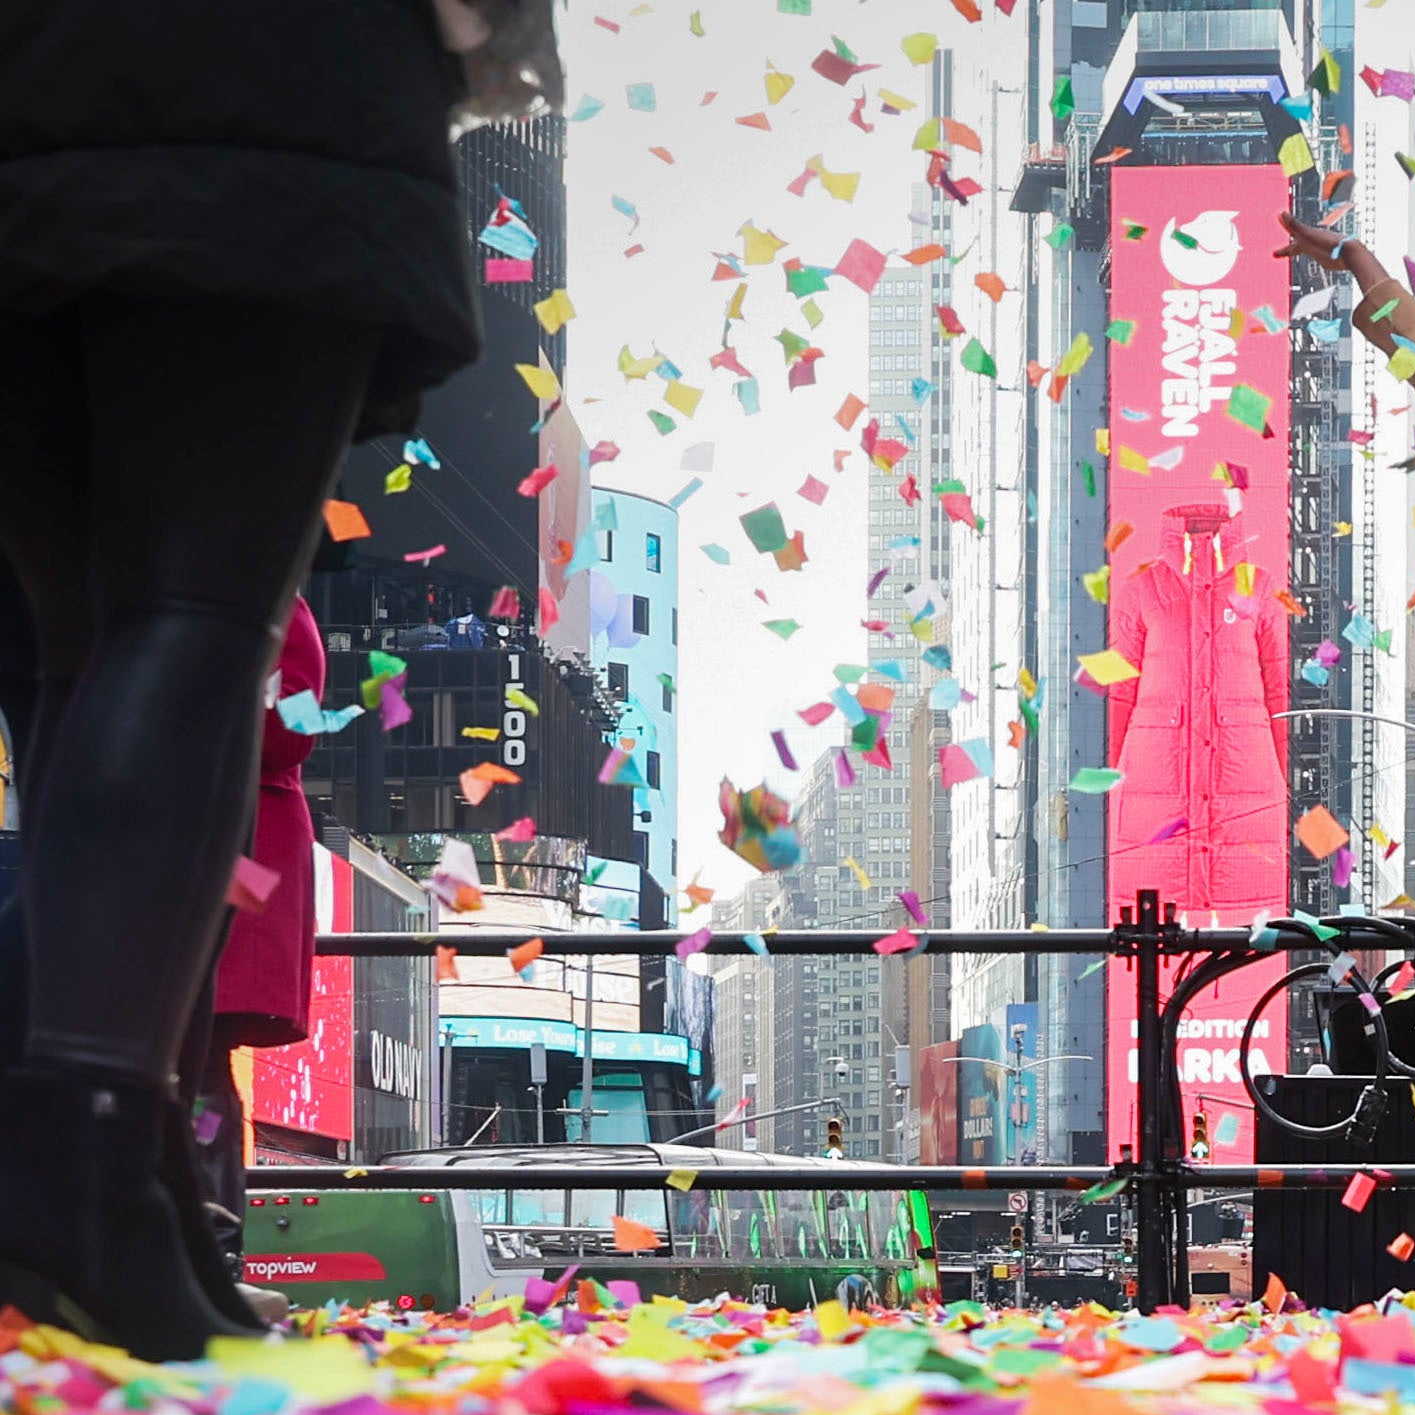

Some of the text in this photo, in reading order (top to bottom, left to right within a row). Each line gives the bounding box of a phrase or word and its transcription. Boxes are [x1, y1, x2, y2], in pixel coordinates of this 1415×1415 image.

[1143, 77, 1268, 93] one times square
[504, 653, 526, 766] 1500
[370, 1030, 422, 1101] OLD NAVY
